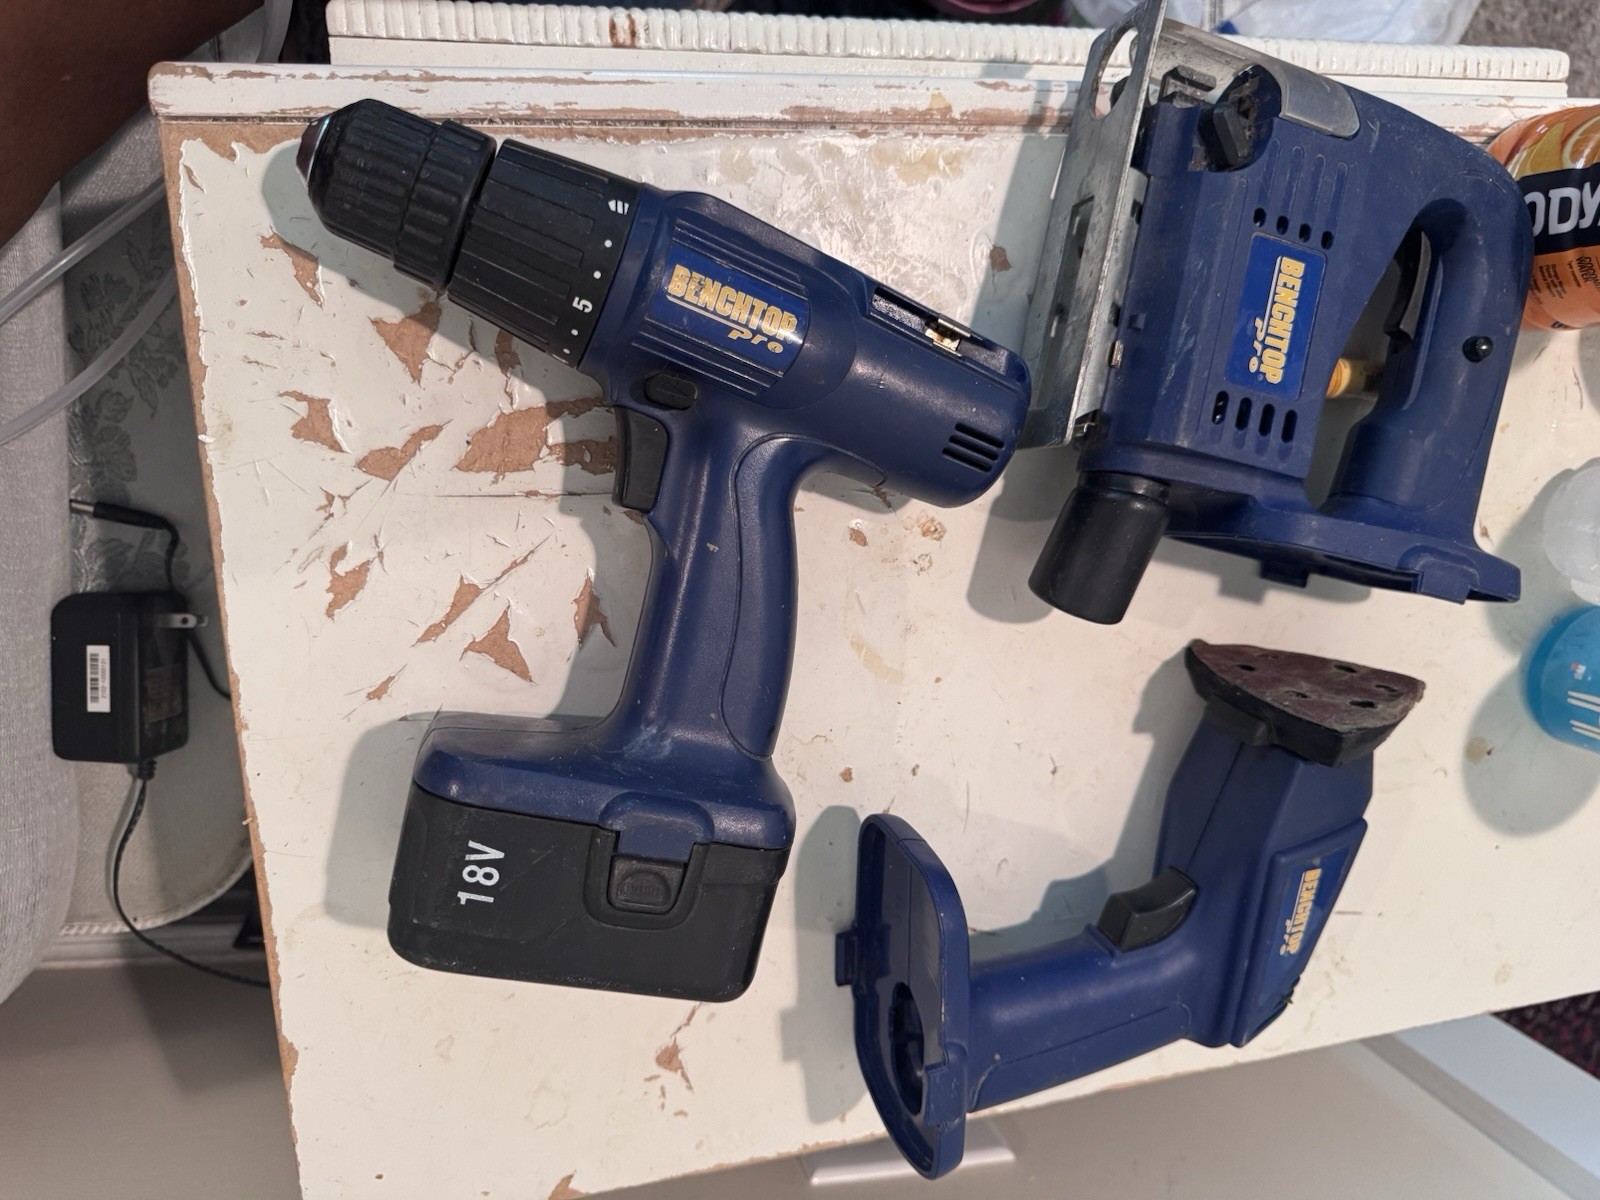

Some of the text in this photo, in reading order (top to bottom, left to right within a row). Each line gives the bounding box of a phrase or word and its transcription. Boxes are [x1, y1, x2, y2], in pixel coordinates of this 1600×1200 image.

[1524, 181, 1600, 237] ODY
[572, 296, 593, 314] 5
[667, 264, 798, 341] BENCHTOP
[1260, 256, 1306, 384] BENCHTOP
[457, 839, 505, 905] 18V
[1286, 867, 1322, 955] BENCHTOP
